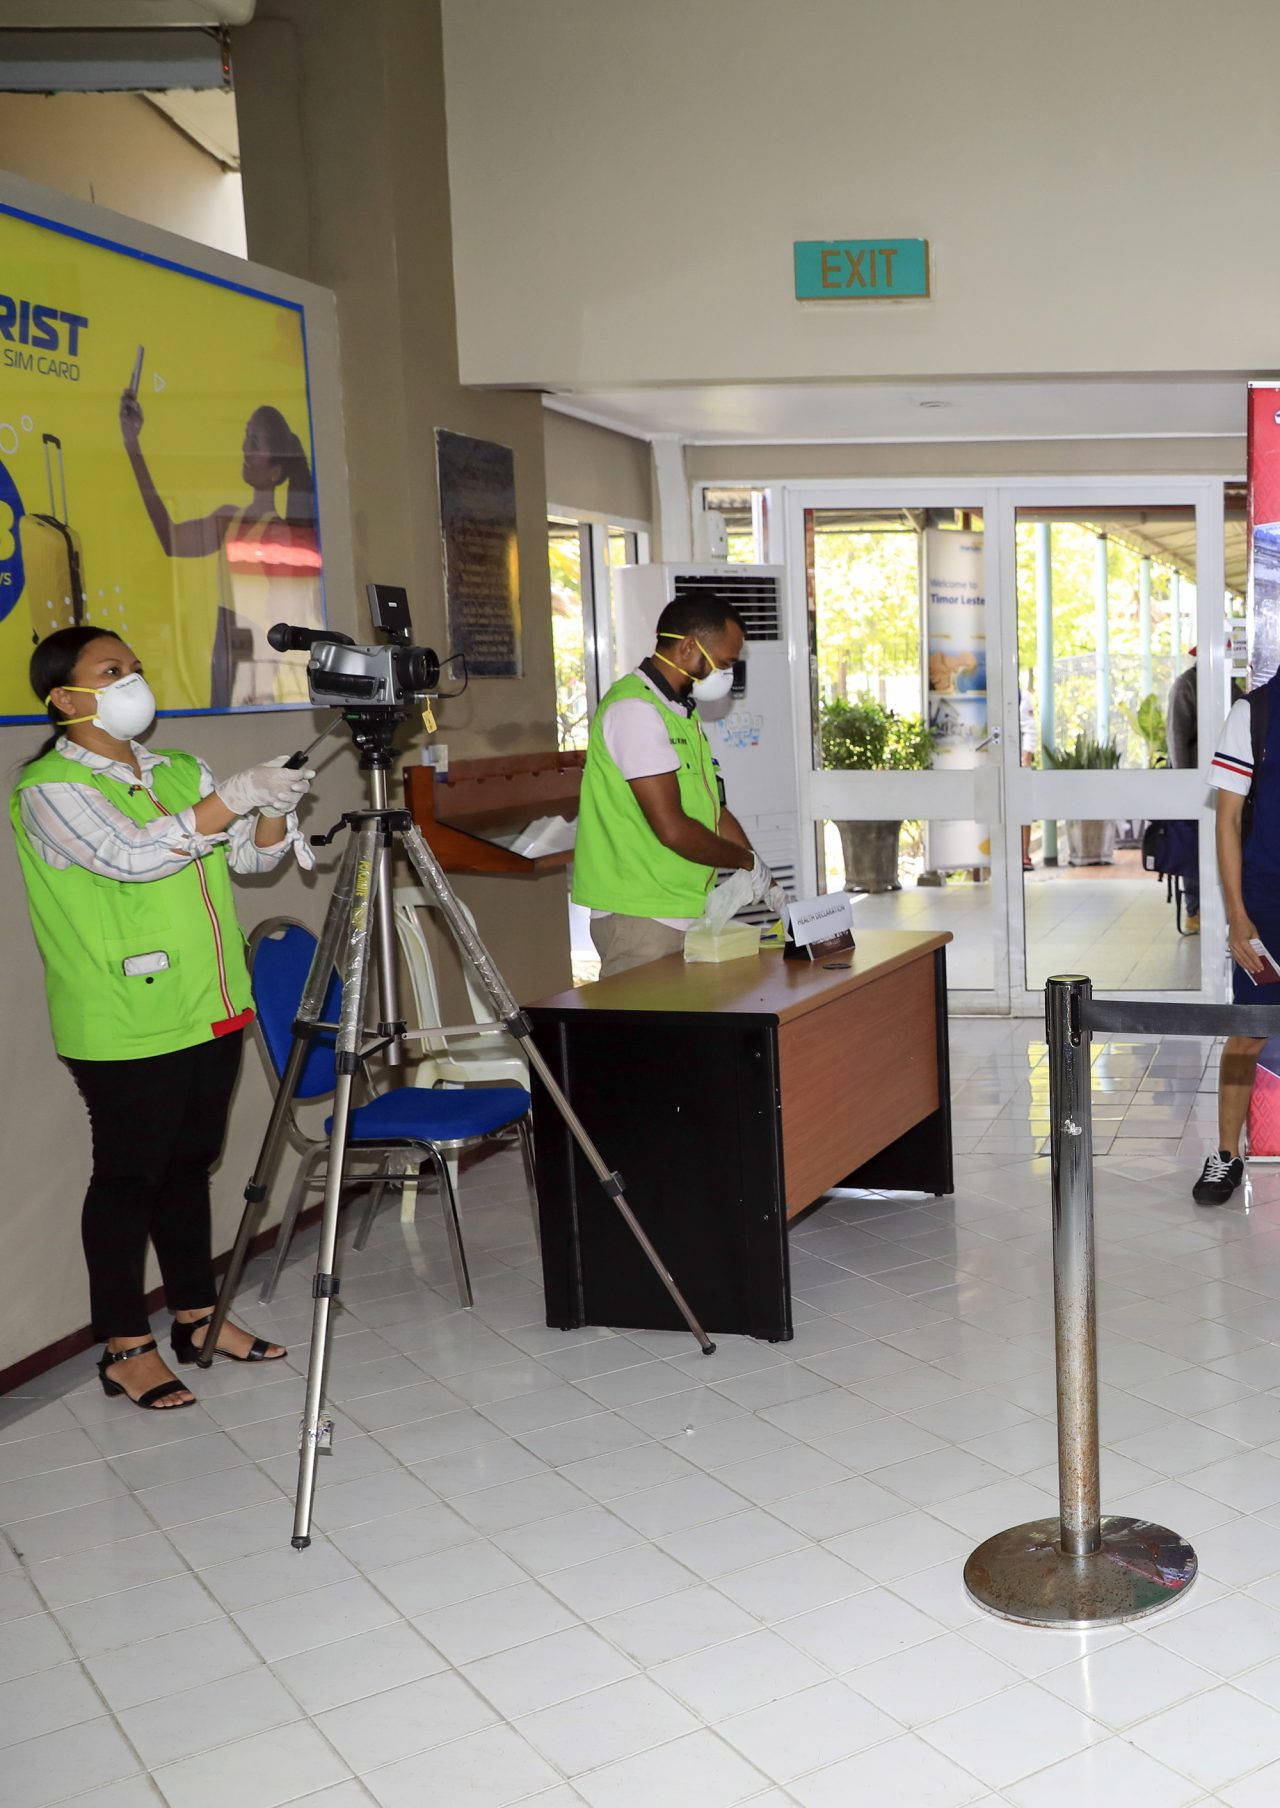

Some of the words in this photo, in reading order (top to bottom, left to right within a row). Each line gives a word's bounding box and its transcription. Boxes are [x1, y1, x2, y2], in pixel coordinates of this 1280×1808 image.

[821, 248, 898, 288] EXIT
[3, 348, 33, 371] SIM
[37, 356, 81, 382] CARD
[931, 593, 958, 604] Timor
[961, 595, 985, 606] Leste
[797, 915, 815, 926] HEALTH
[815, 904, 846, 920] DECLARATION
